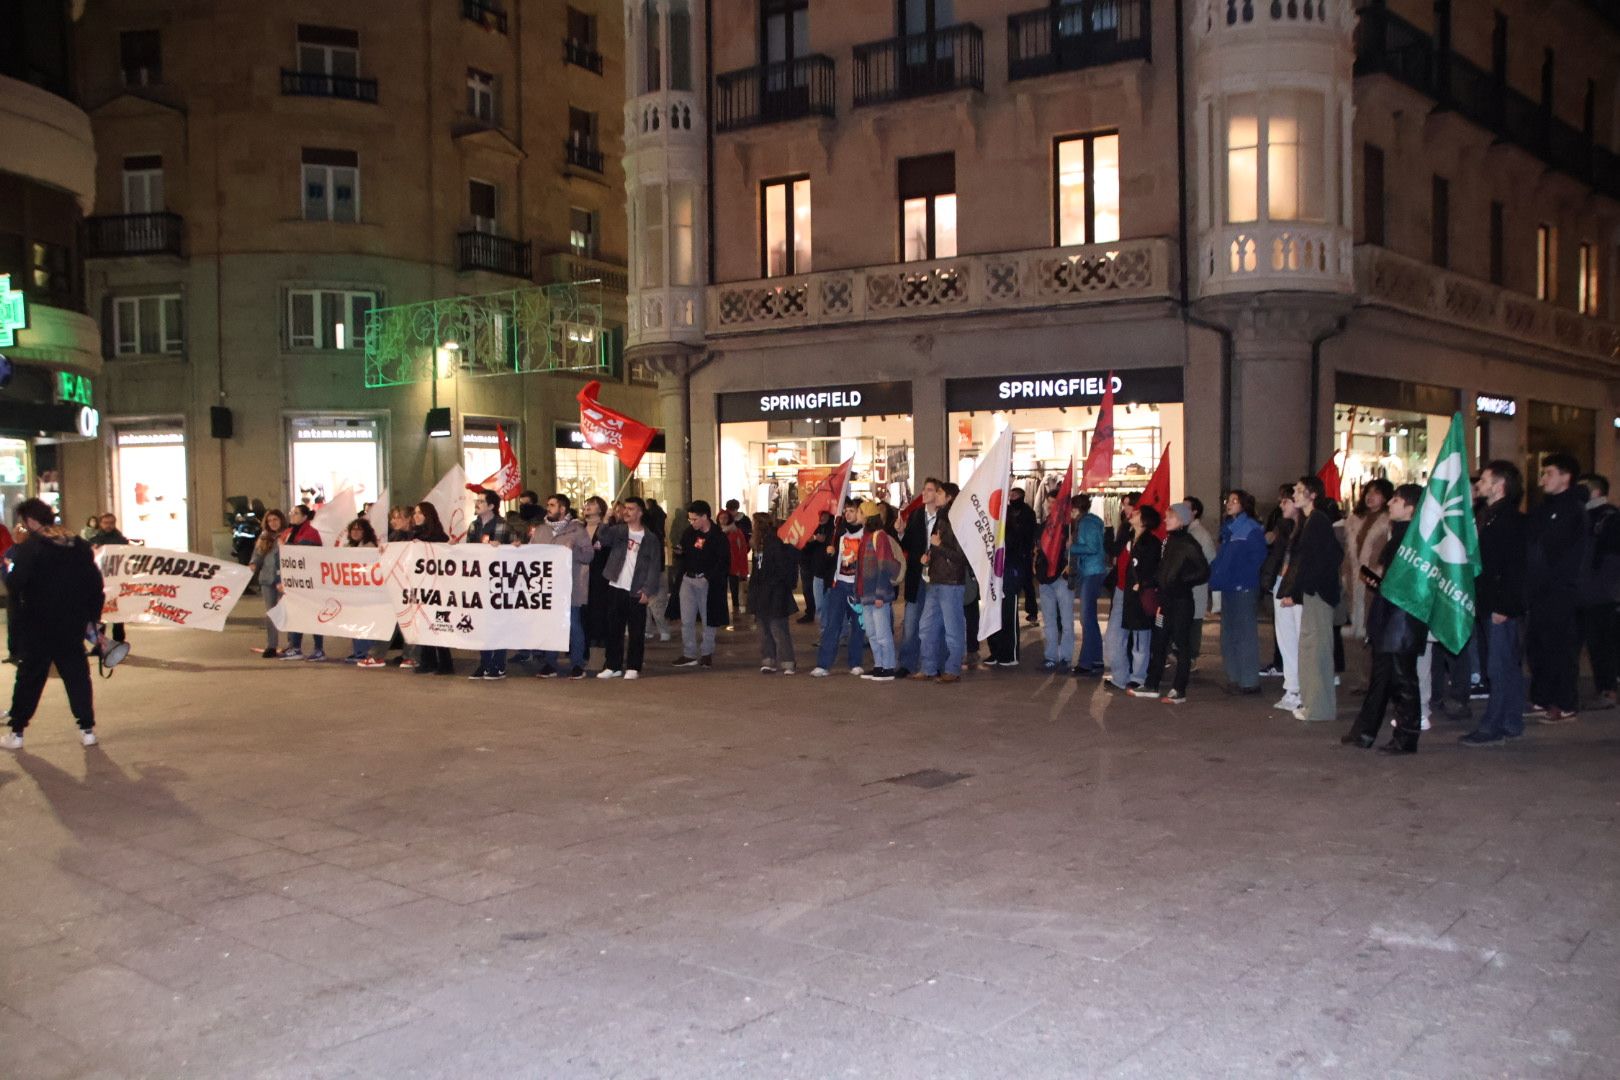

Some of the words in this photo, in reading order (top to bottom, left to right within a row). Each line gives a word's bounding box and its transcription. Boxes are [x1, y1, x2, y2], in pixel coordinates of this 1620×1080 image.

[1000, 377, 1122, 399] SPRINGFIELD
[760, 391, 861, 411] SPRINGFIELD
[124, 554, 221, 579] CULPABLES
[282, 558, 296, 569] solo
[298, 557, 305, 569] el
[414, 559, 457, 577] SOLO
[462, 560, 481, 577] LA
[489, 561, 553, 578] CLASE
[284, 576, 305, 588] salva
[306, 577, 313, 589] al
[203, 602, 221, 611] CJC
[462, 591, 483, 609] LA
[490, 592, 552, 610] CLASE
